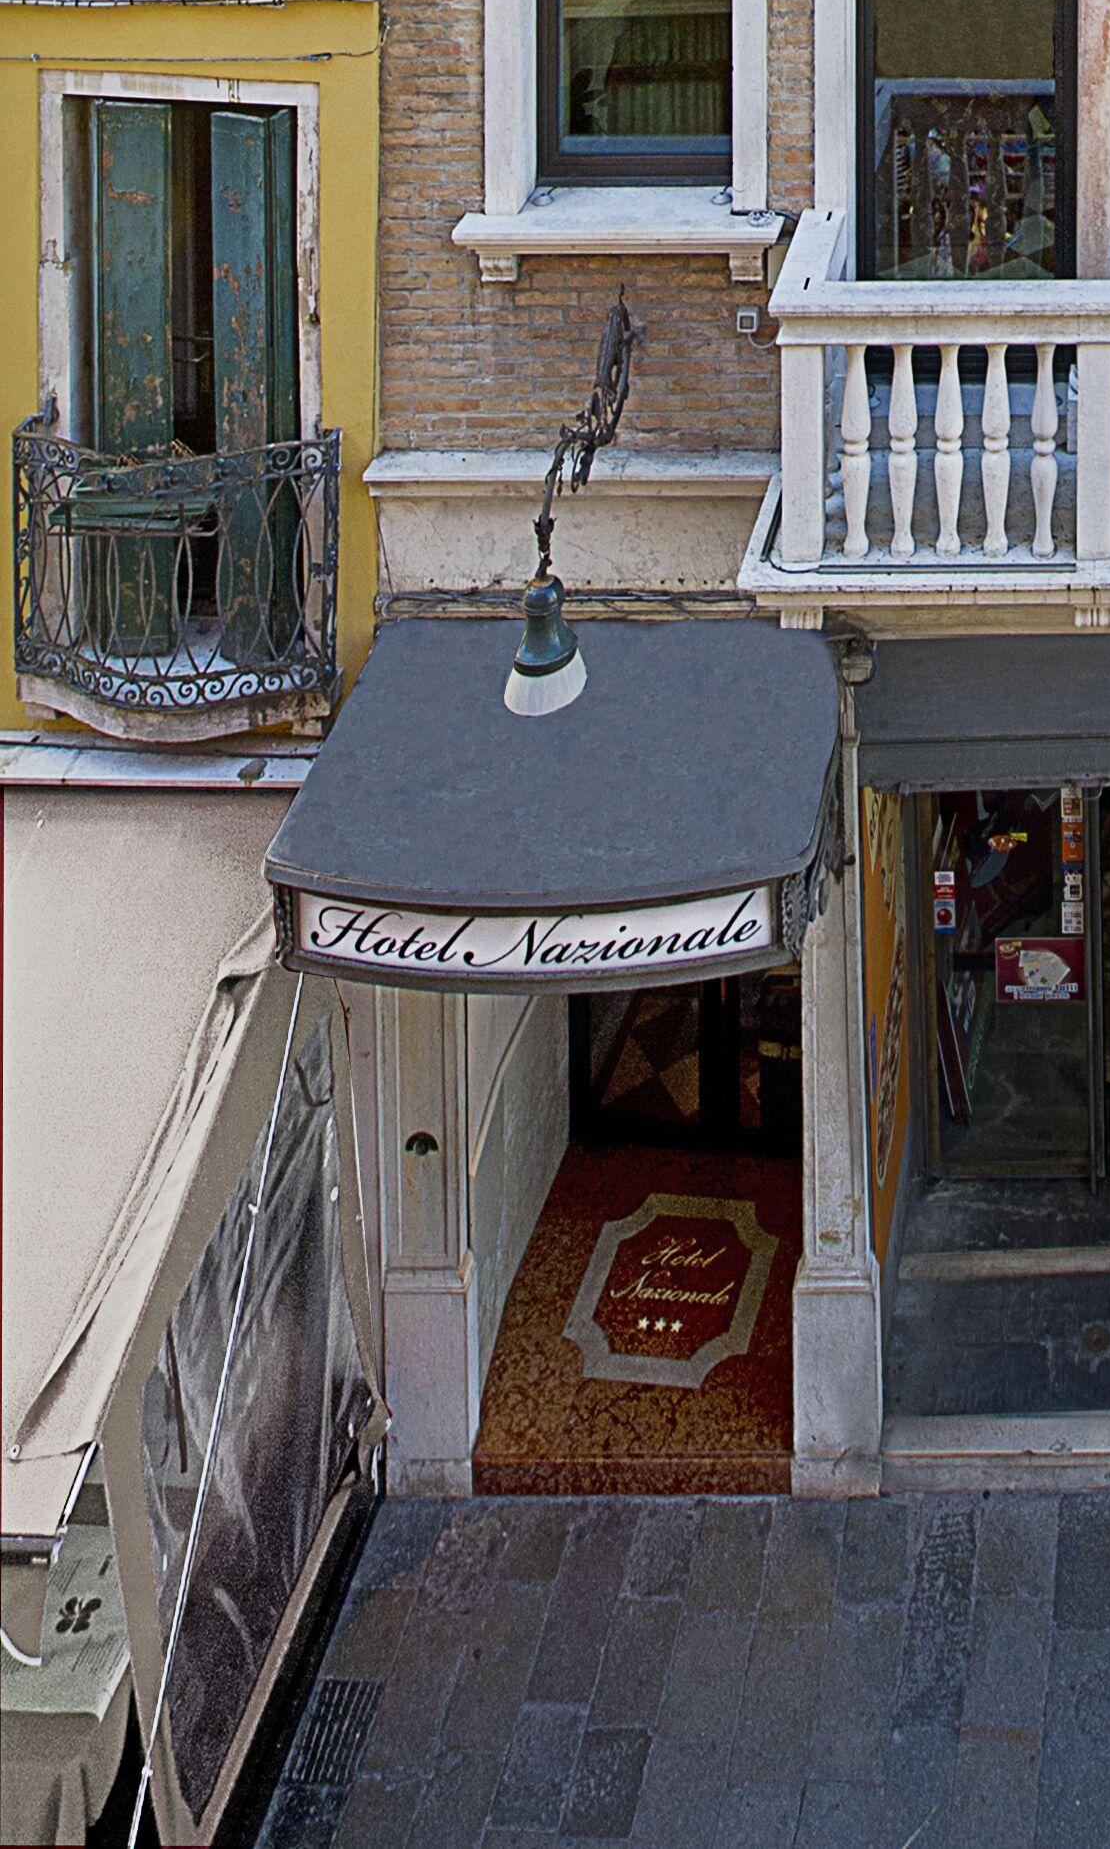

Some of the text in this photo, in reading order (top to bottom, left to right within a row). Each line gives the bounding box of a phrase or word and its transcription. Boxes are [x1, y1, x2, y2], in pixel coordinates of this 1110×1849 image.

[310, 890, 763, 969] Hotel Nazionale
[641, 1236, 727, 1269] Hotel
